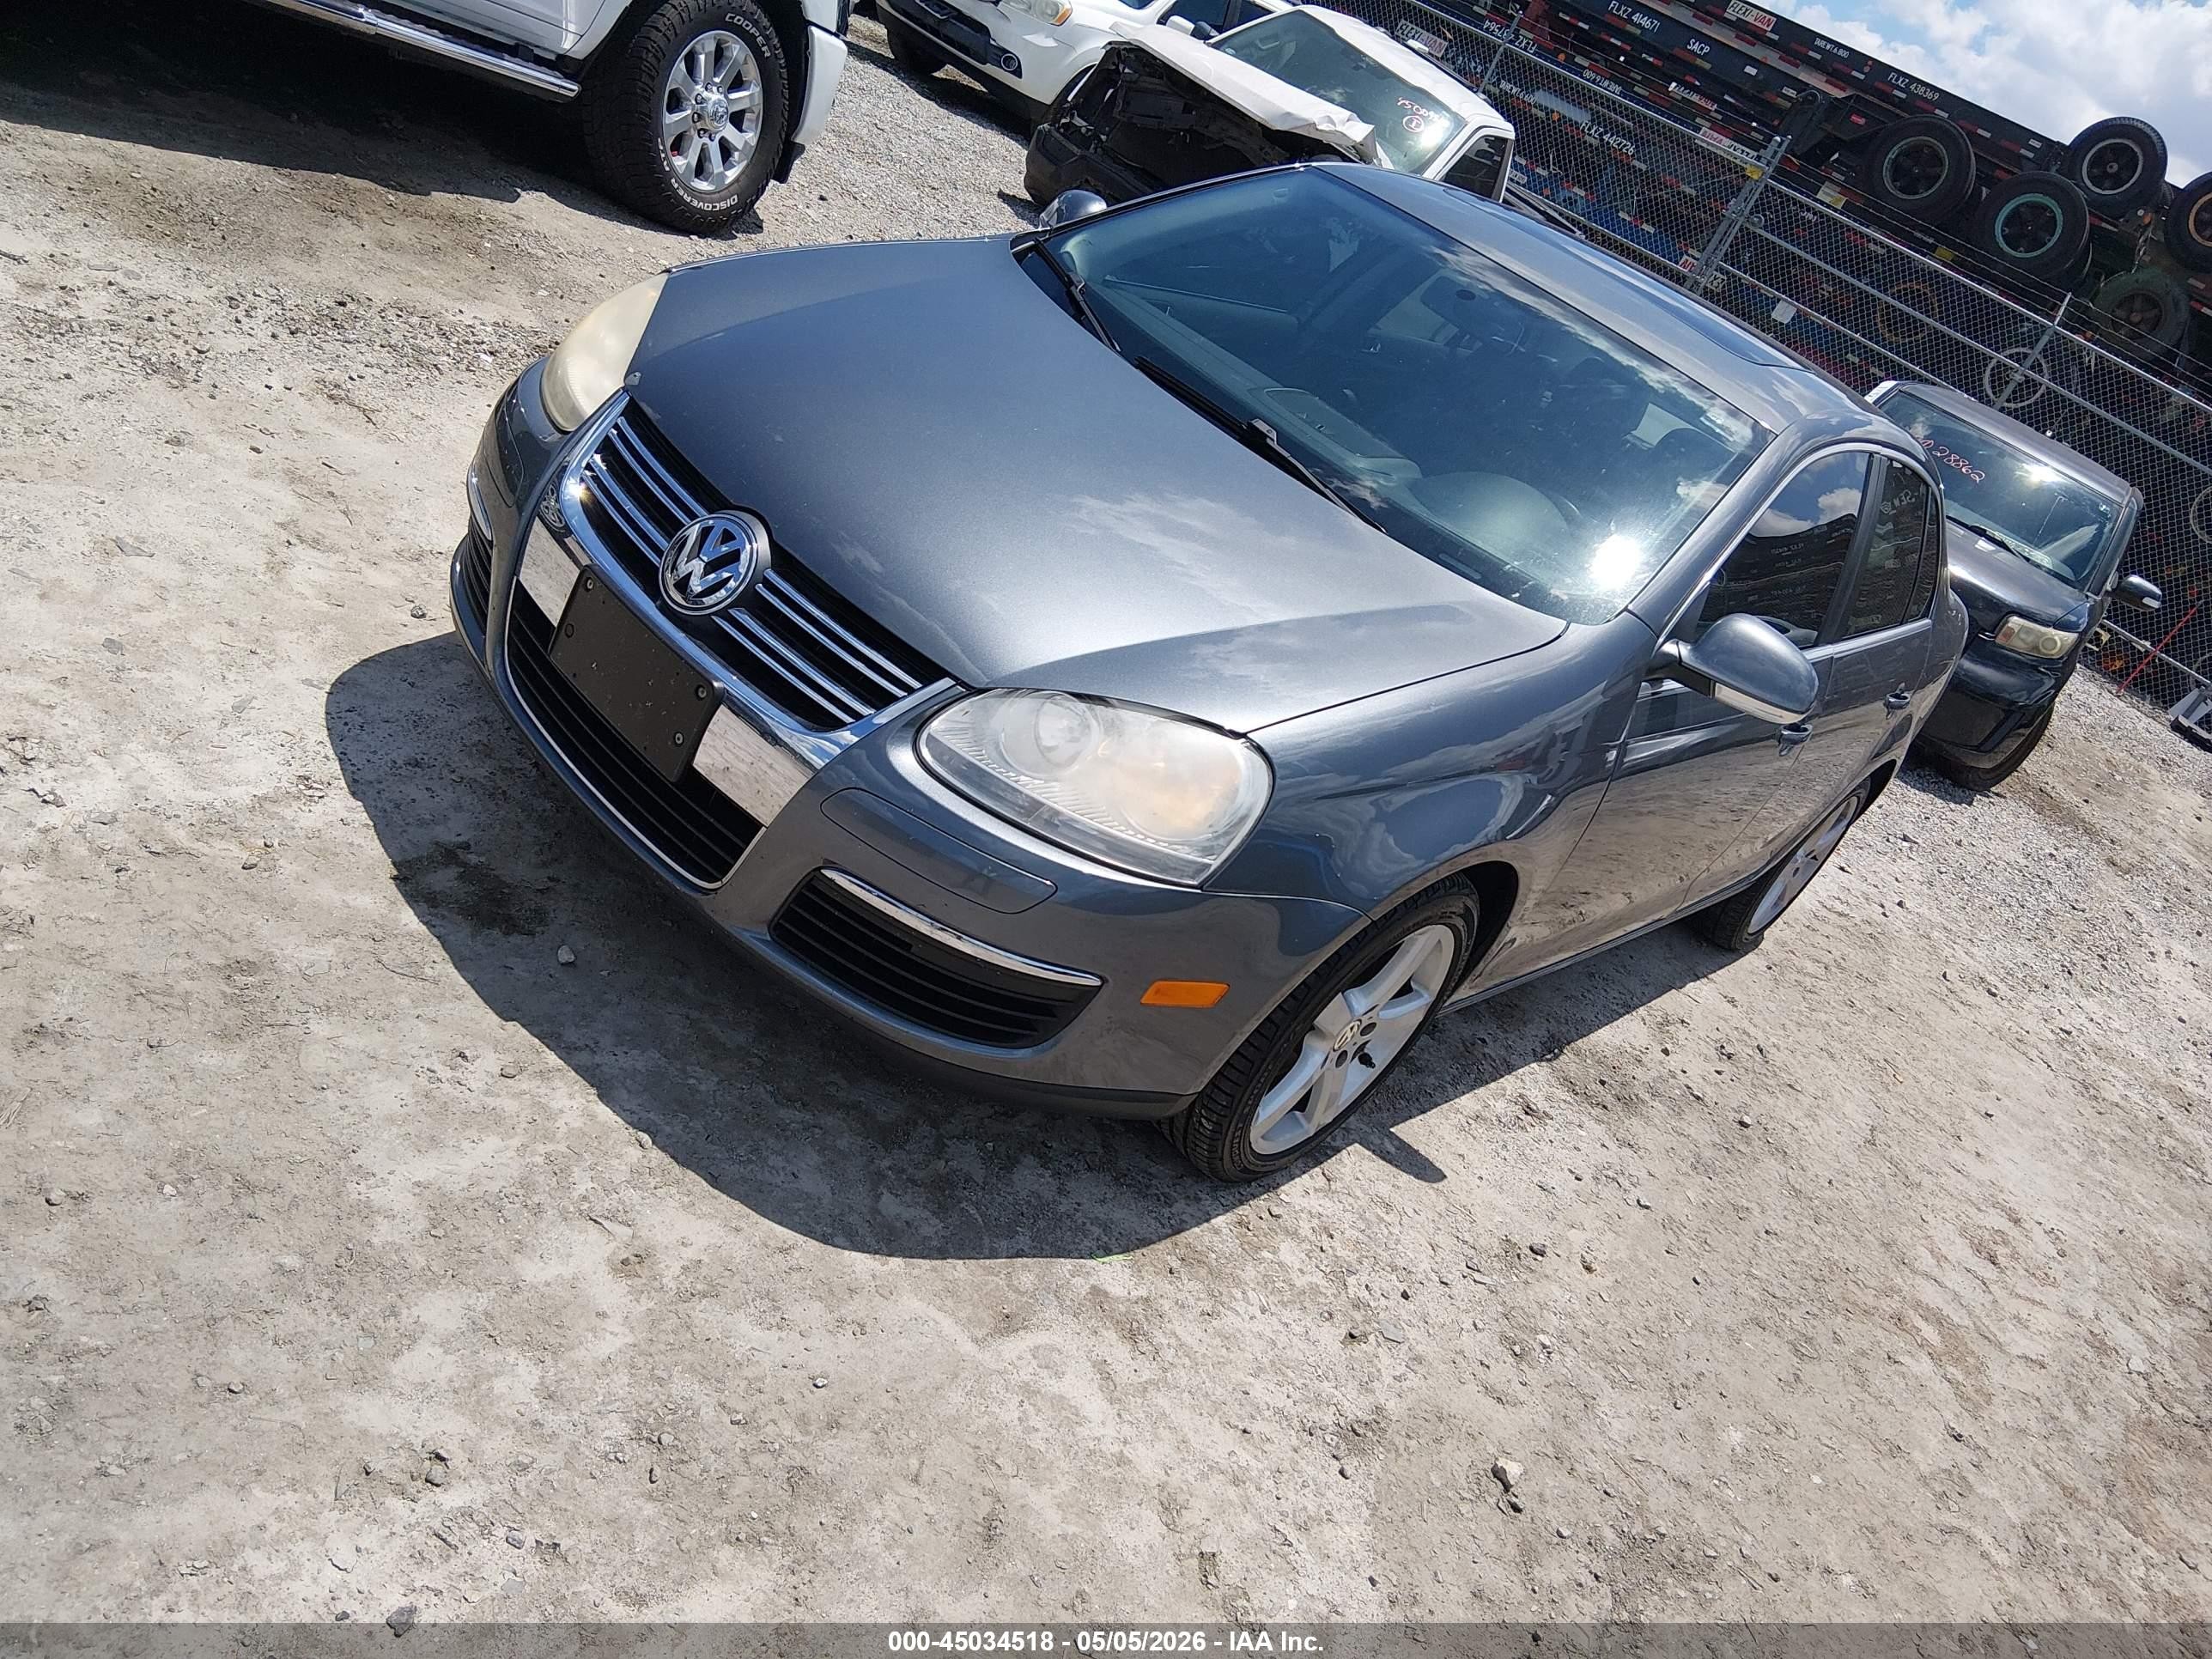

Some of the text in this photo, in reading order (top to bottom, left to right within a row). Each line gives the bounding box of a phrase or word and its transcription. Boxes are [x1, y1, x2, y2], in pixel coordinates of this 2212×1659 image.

[1608, 1, 1660, 33] FLXZ 414671
[1728, 2, 1774, 28] FLEXI-VAN
[725, 13, 771, 58] COOPER
[1514, 33, 1537, 53] FLXZ
[1687, 39, 1710, 56] SACP
[1887, 72, 1940, 101] FLXZ 438369
[1580, 120, 1634, 155] FLXZ 442726
[671, 177, 738, 211] DISCOVERER
[660, 514, 758, 615] VW
